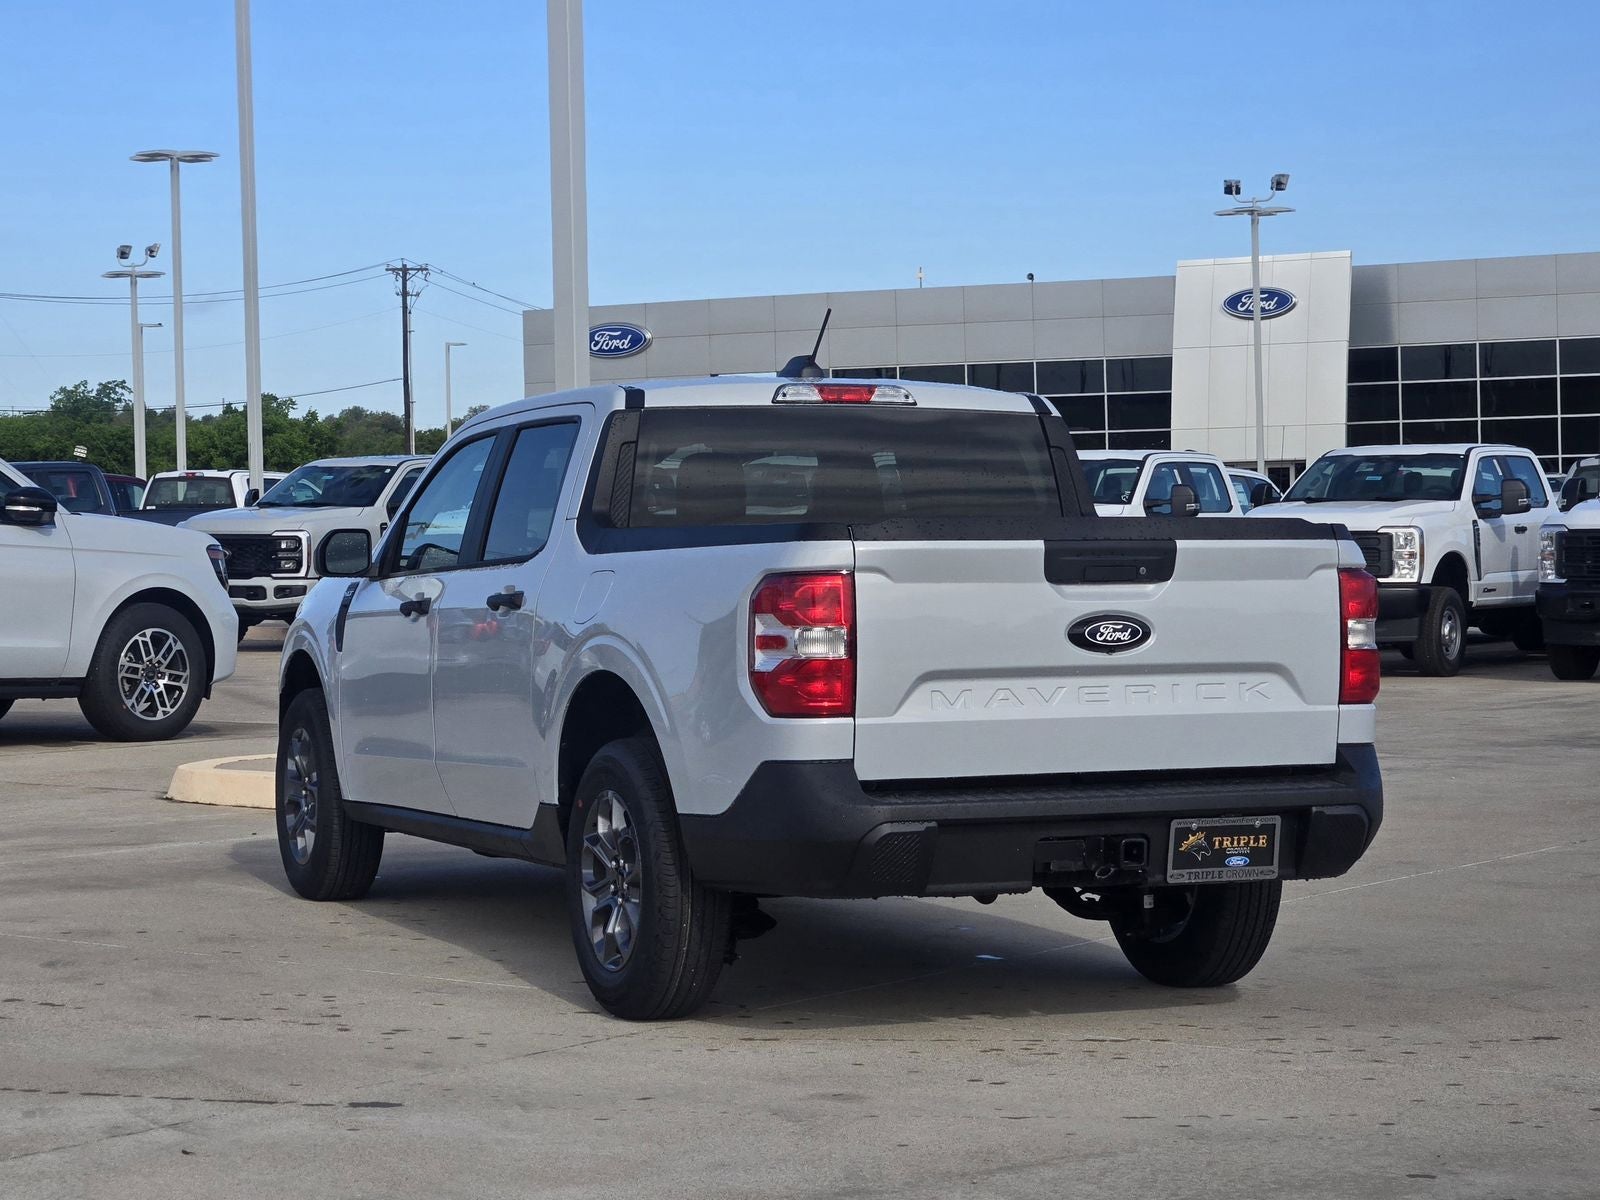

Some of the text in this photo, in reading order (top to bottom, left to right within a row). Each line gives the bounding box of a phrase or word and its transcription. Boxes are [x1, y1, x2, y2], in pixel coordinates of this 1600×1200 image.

[591, 331, 632, 351] Ford
[1096, 624, 1131, 641] Ford
[929, 680, 1272, 711] MAVERICK
[1212, 835, 1267, 849] TRIPLE
[1225, 846, 1250, 854] CROWN
[1186, 870, 1224, 881] TRIPLE
[1225, 868, 1259, 879] CROWN
